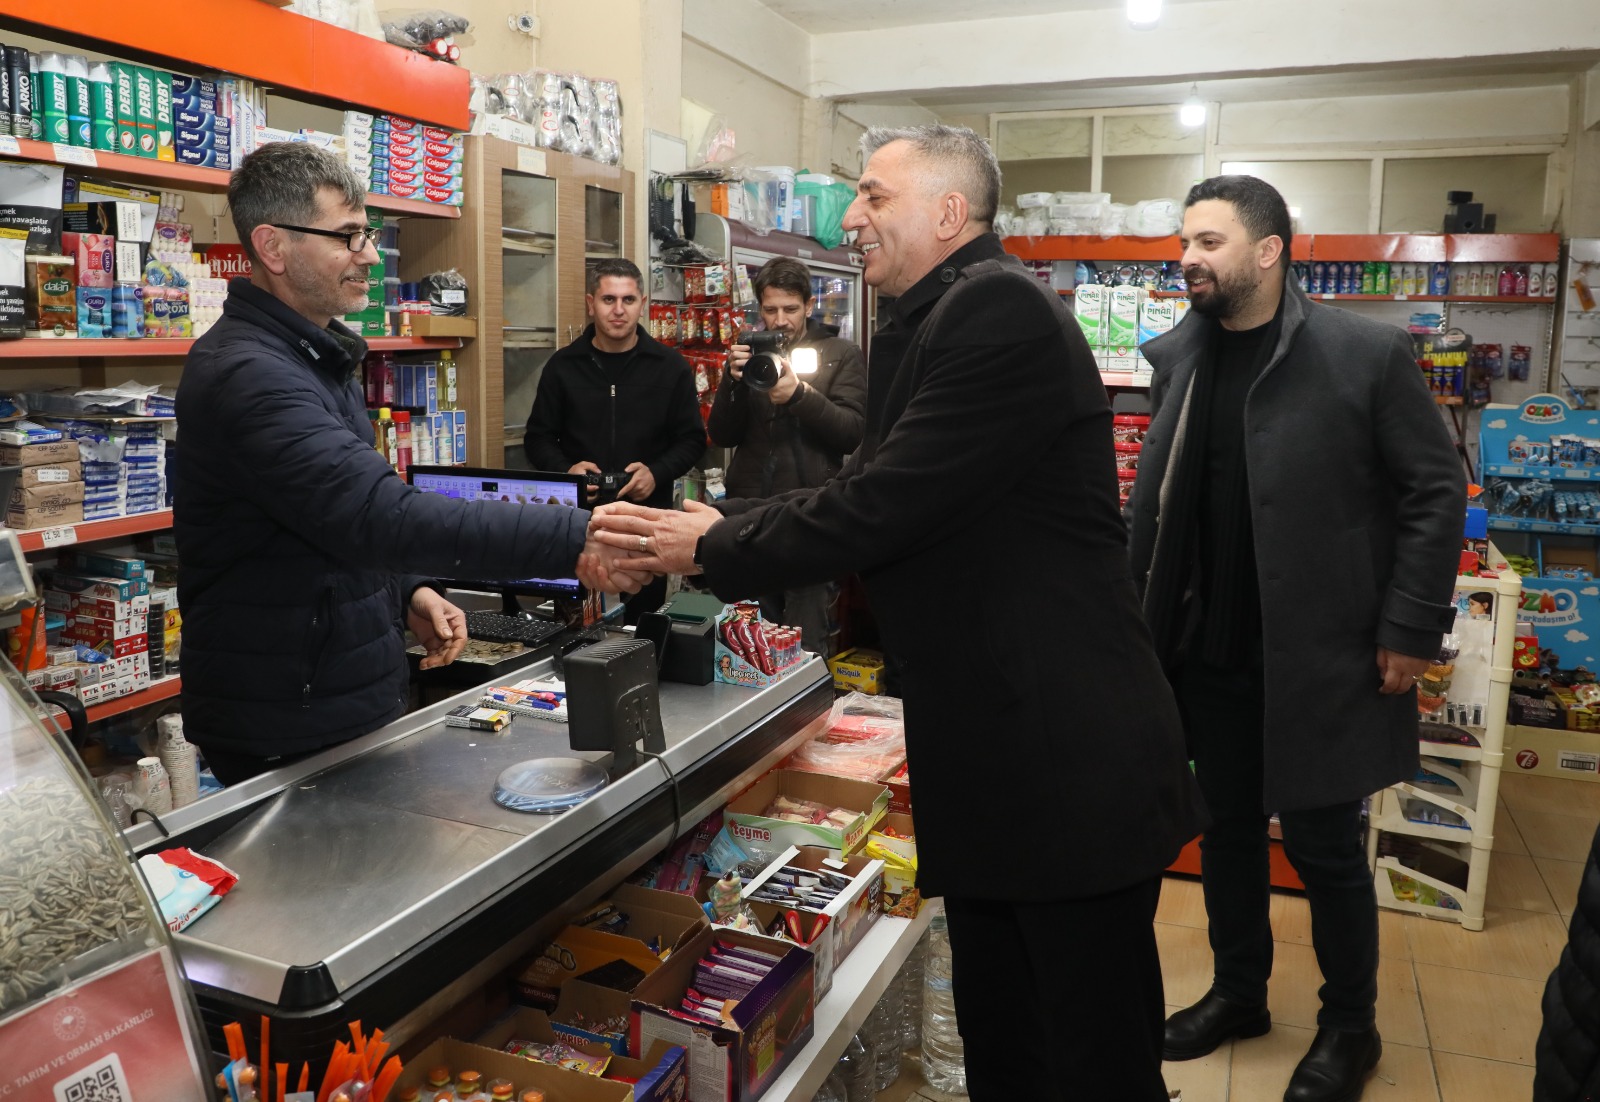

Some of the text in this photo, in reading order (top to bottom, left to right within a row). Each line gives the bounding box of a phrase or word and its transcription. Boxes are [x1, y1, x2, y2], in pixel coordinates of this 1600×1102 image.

[19, 75, 31, 112] ARKO
[53, 74, 65, 111] DERBY
[119, 68, 132, 116] DERBY
[138, 72, 152, 119] DERBY
[78, 80, 89, 116] DERBY
[104, 84, 114, 120] DERBY
[157, 77, 170, 124] DERBY
[180, 112, 199, 122] Signal
[215, 119, 228, 127] NOW
[391, 117, 412, 129] Colgate
[181, 130, 199, 141] Signal
[390, 131, 412, 141] Colgate
[426, 129, 448, 139] Colgate
[390, 144, 413, 154] Colgate
[427, 142, 450, 154] Colgate
[182, 149, 201, 159] Signal
[216, 155, 229, 163] NOW
[391, 157, 413, 168] Colgate
[426, 158, 449, 169] Colgate
[391, 170, 414, 181] Colgate
[425, 173, 449, 183] Colgate
[391, 184, 414, 194] Colgate
[426, 188, 450, 199] Colgate
[43, 281, 69, 292] dalan
[1117, 293, 1136, 301] PINAR
[1147, 306, 1172, 315] PINAR
[1526, 404, 1561, 417] OZMO
[836, 666, 861, 678] Nesquik
[733, 825, 771, 841] teyme
[553, 1029, 591, 1046] HARIBO
[14, 1064, 50, 1088] TARIM
[51, 1055, 65, 1069] VE
[66, 1034, 104, 1061] ORMAN
[103, 1008, 154, 1041] BAKANLIĞI
